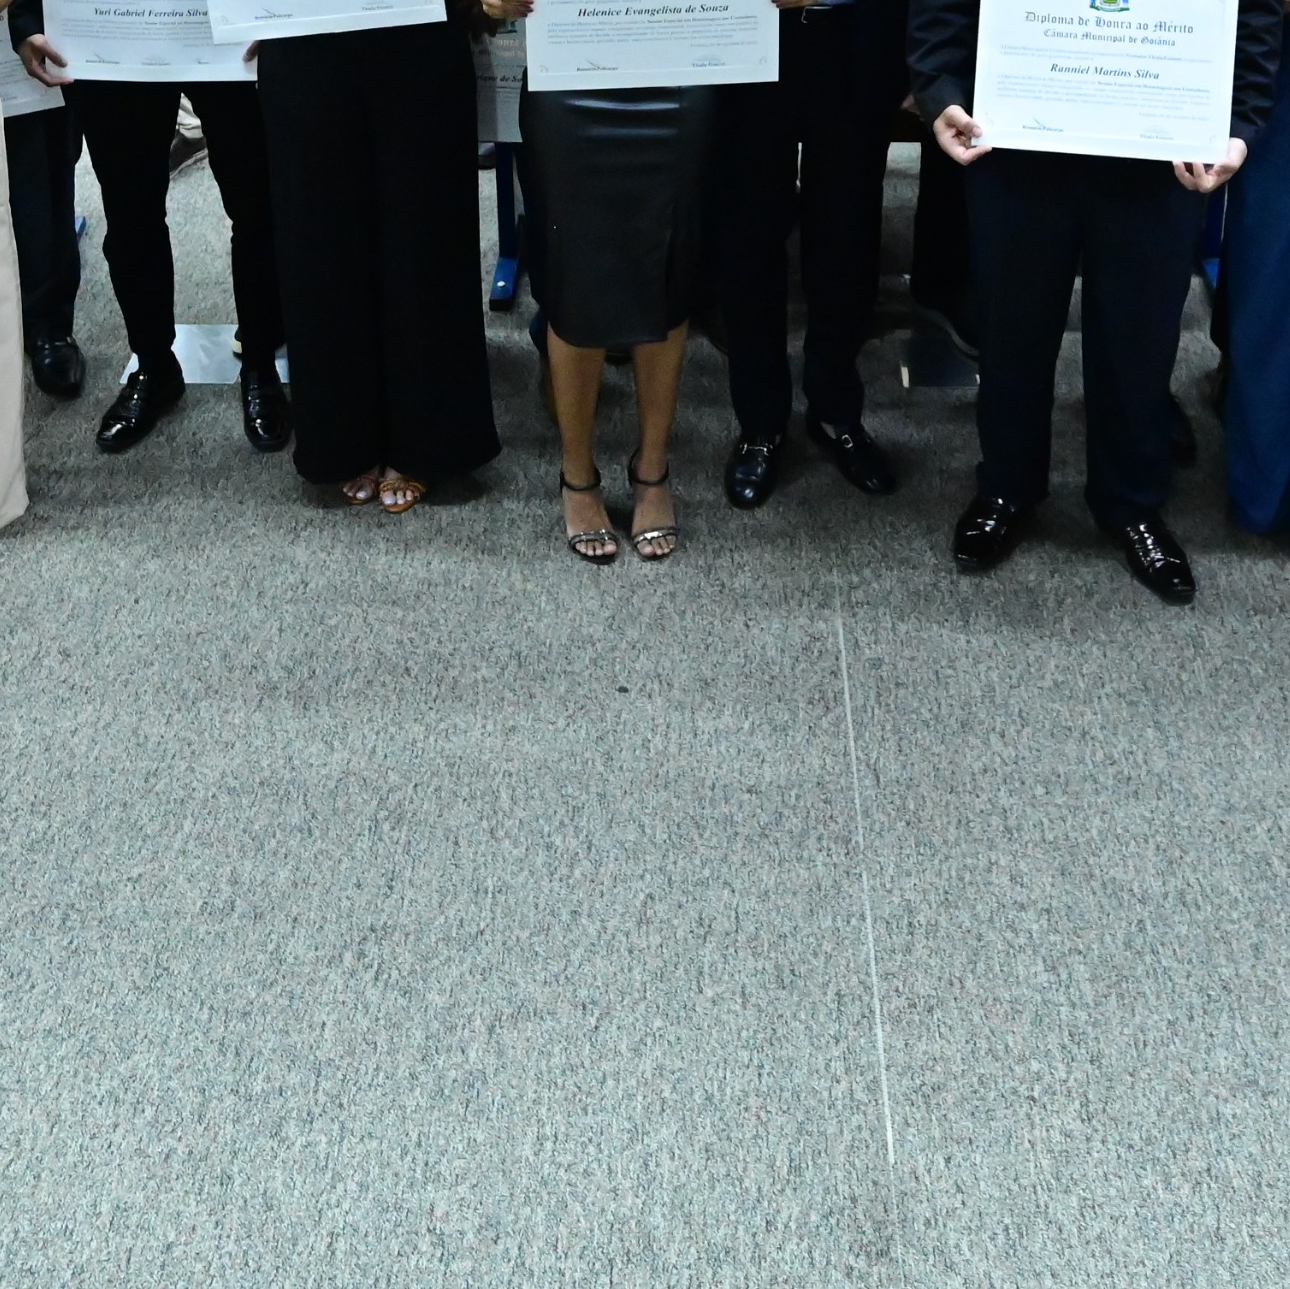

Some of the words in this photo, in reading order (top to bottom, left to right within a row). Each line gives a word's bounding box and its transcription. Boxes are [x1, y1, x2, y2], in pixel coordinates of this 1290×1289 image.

[94, 7, 111, 16] Yuri
[113, 8, 145, 17] Gabriel
[148, 9, 184, 17] Ferreira
[186, 9, 208, 17] Silva
[577, 7, 622, 17] Helenice
[624, 5, 682, 17] Evangelista
[684, 4, 697, 13] de
[698, 3, 729, 13] Souza
[1025, 11, 1074, 25] Diploma
[1077, 15, 1090, 26] de
[1095, 15, 1132, 29] Honra
[1135, 22, 1149, 31] ao
[1152, 20, 1194, 34] Mérito
[1043, 28, 1078, 39] Câmara
[1080, 31, 1125, 43] Municipal
[1128, 35, 1138, 44] de
[1140, 36, 1176, 46] Goiânia
[1050, 63, 1090, 74] Ranniel
[1094, 66, 1131, 77] Martins
[1134, 69, 1160, 79] Silva
